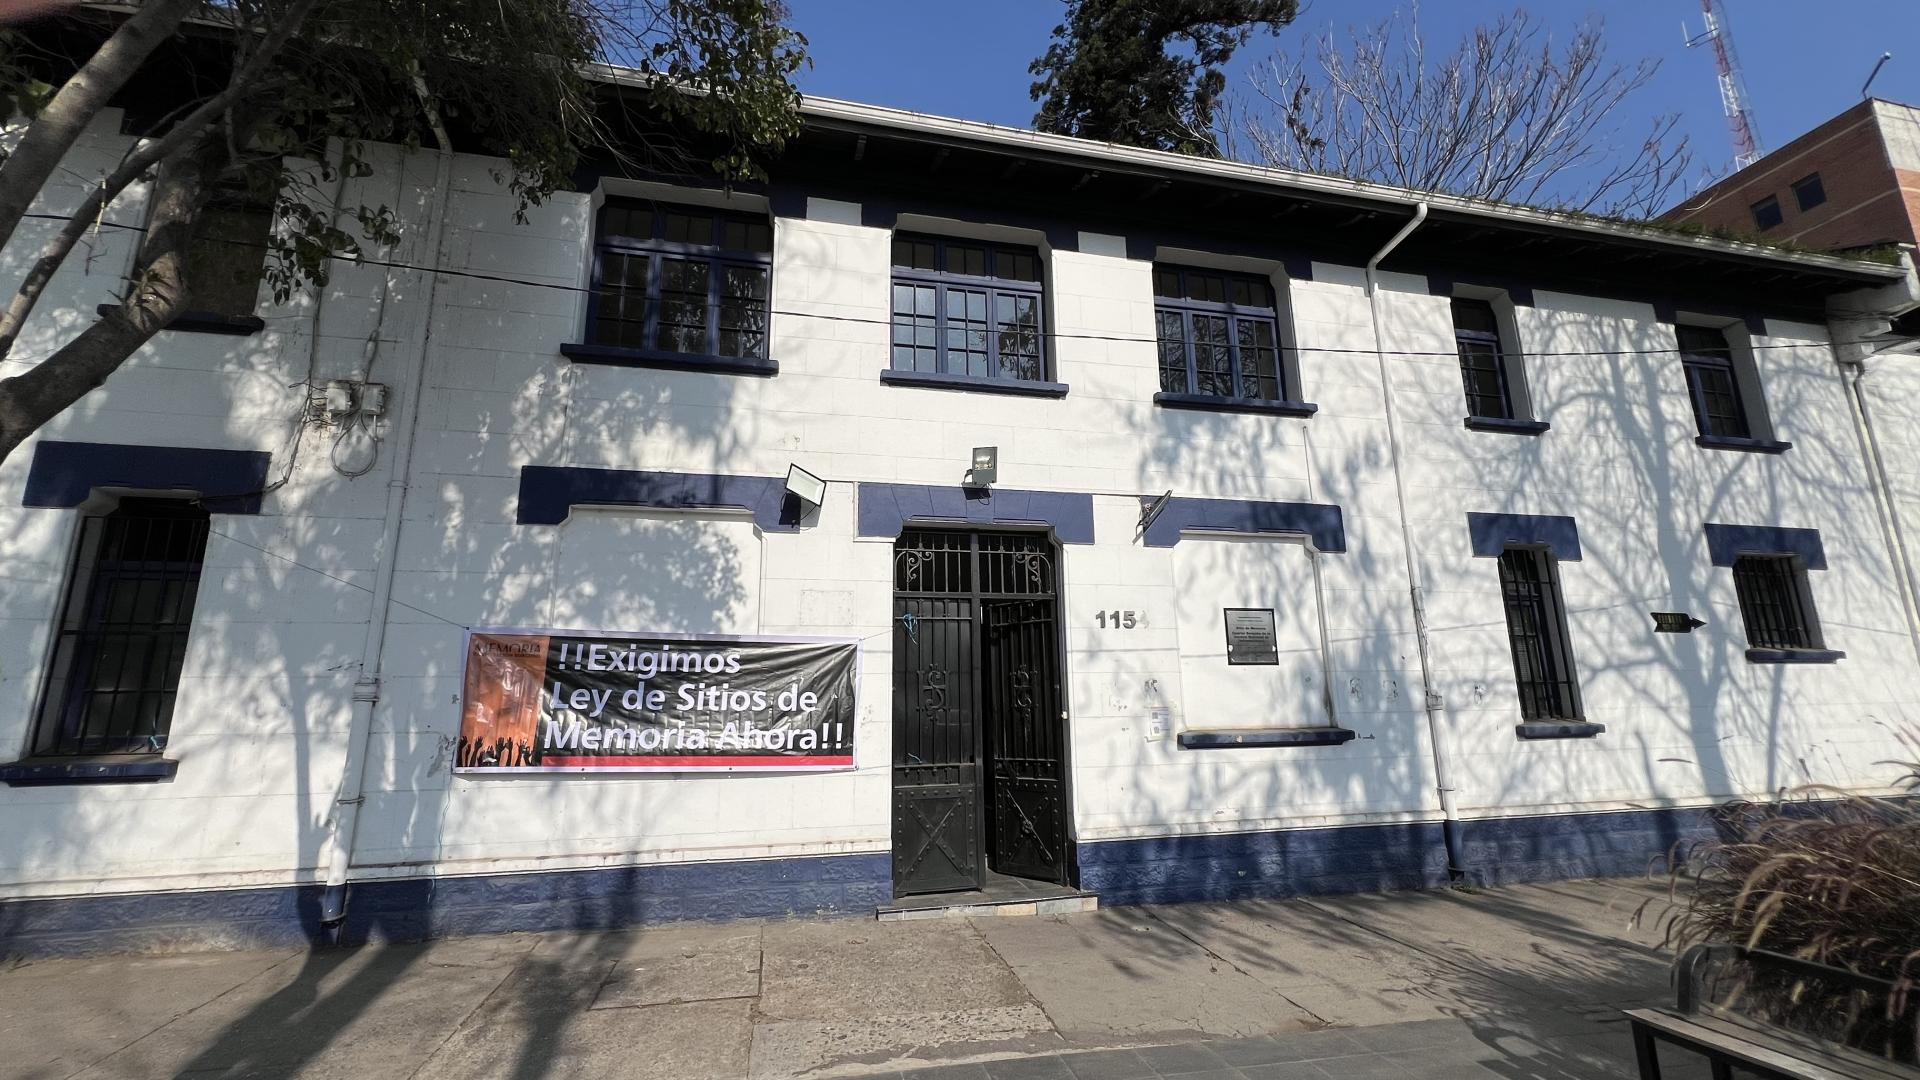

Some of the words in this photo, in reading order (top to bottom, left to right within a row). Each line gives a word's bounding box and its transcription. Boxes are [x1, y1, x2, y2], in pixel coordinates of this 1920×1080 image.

[558, 643, 741, 679] !!Exigimos
[551, 681, 612, 718] Ley
[622, 681, 665, 711] de
[677, 682, 767, 711] Sitios
[777, 683, 818, 712] de
[543, 720, 706, 750] Memoria
[714, 720, 843, 750] Ahora!!
